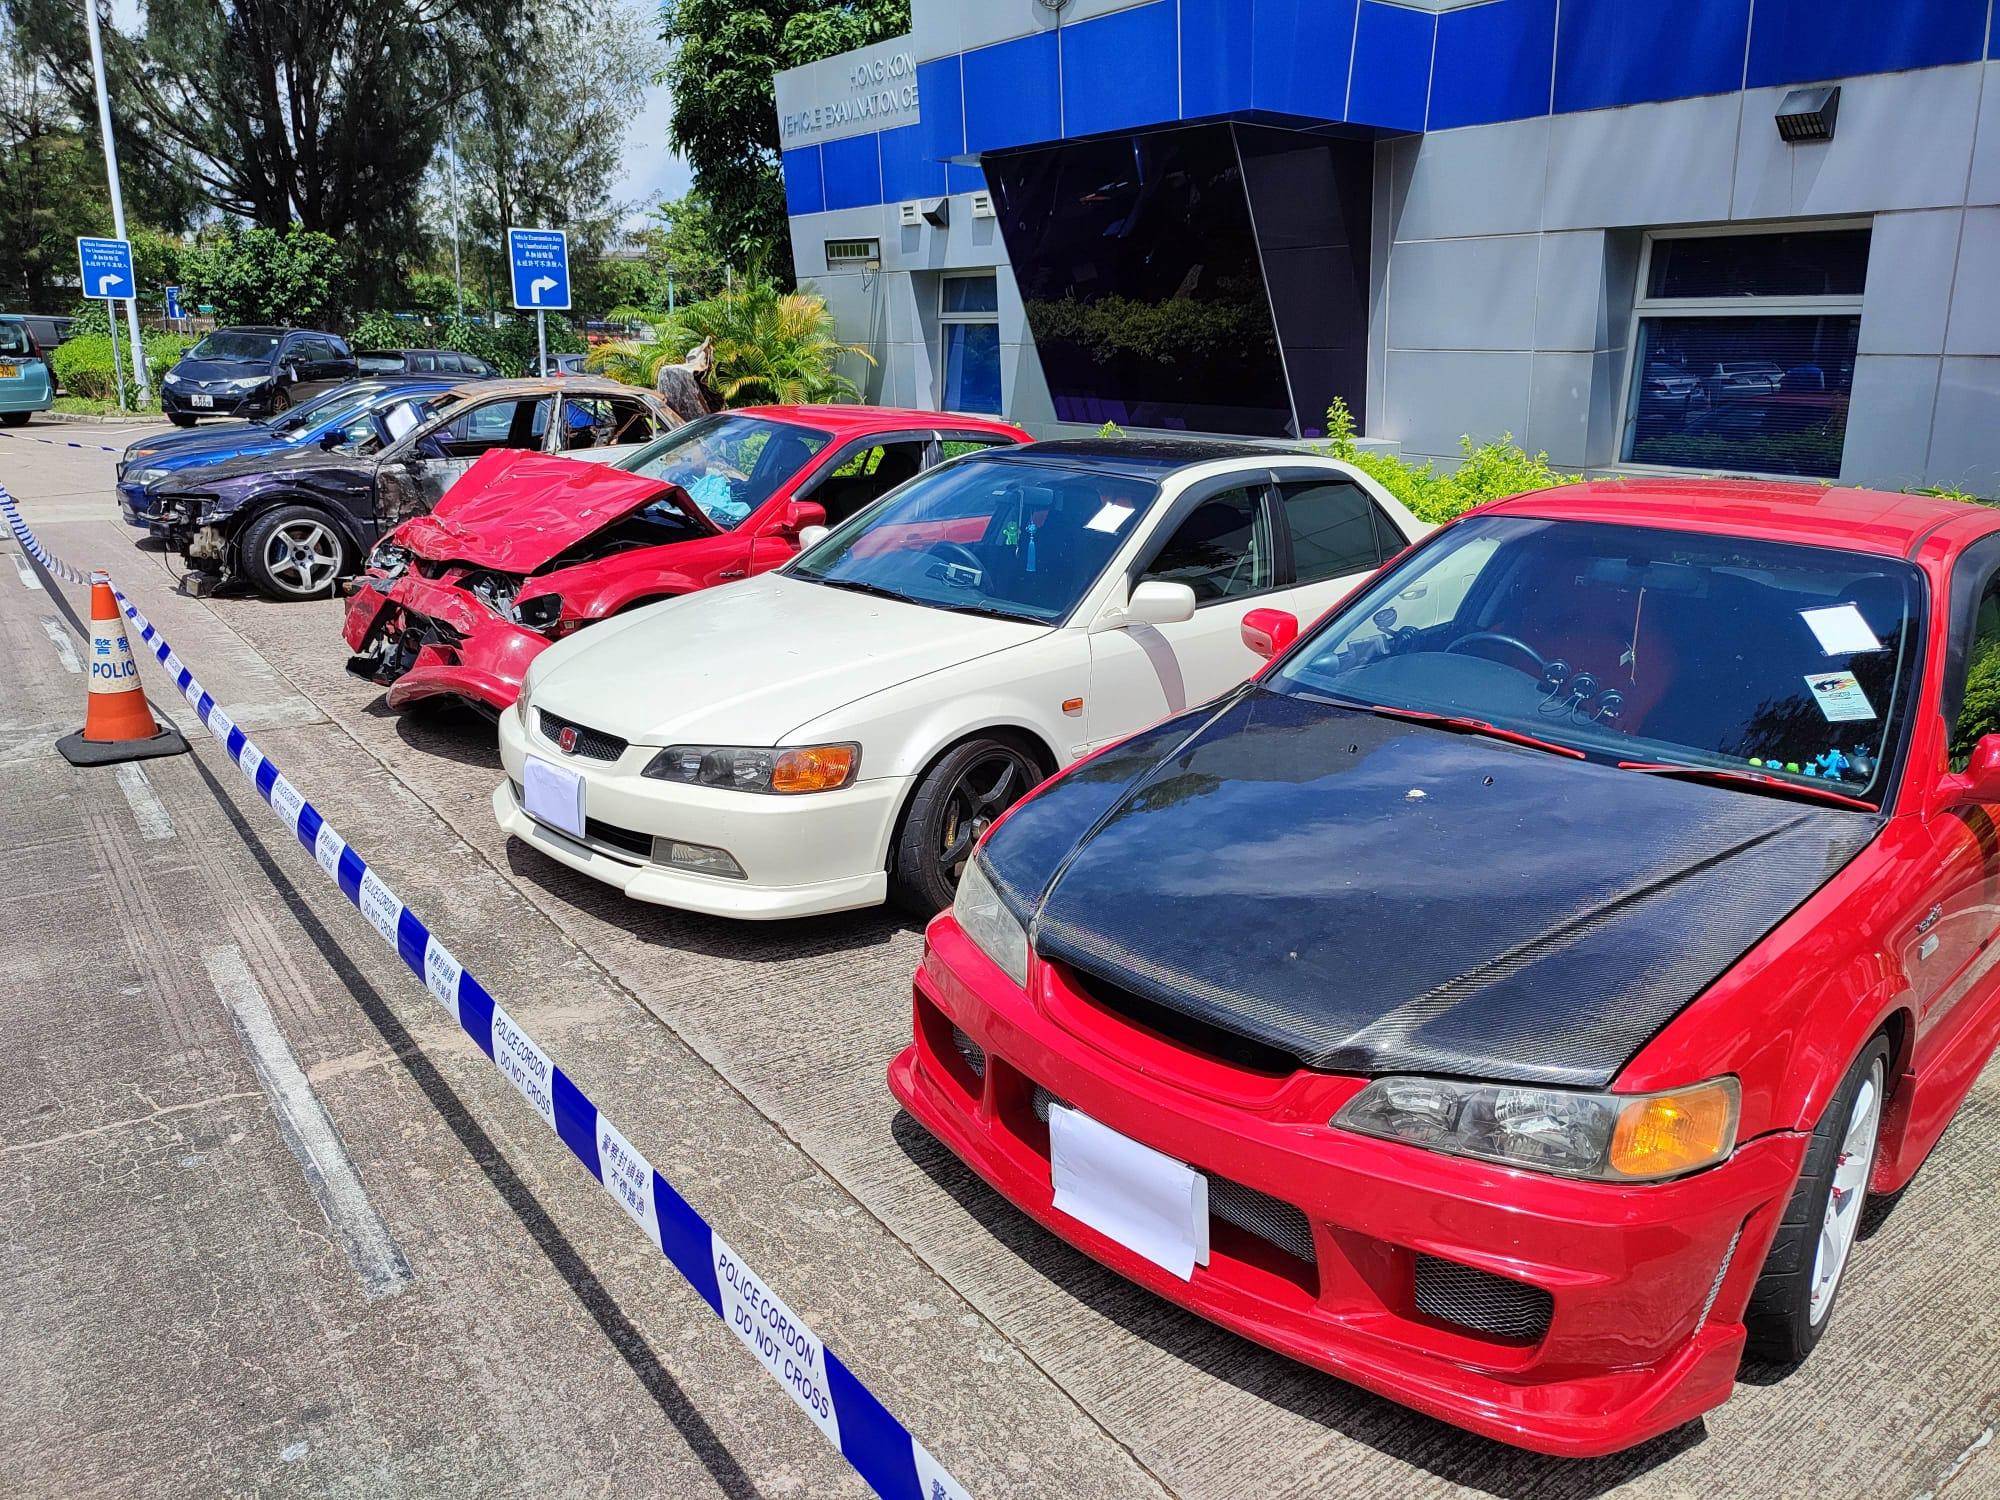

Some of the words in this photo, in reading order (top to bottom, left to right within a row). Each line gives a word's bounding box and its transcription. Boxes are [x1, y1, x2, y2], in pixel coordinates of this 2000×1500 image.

[901, 84, 919, 110] CE
[362, 875, 381, 899] POLICE
[364, 899, 371, 916] DO
[371, 908, 380, 926] NOT
[494, 1017, 520, 1051] POLICE
[501, 1051, 511, 1071] DO
[511, 1062, 526, 1087] NOT
[527, 1079, 551, 1115] CROSS
[718, 1253, 761, 1311] POLICE
[734, 1303, 753, 1335] DO
[754, 1325, 781, 1365] NOT
[784, 1358, 830, 1420] CROSS
